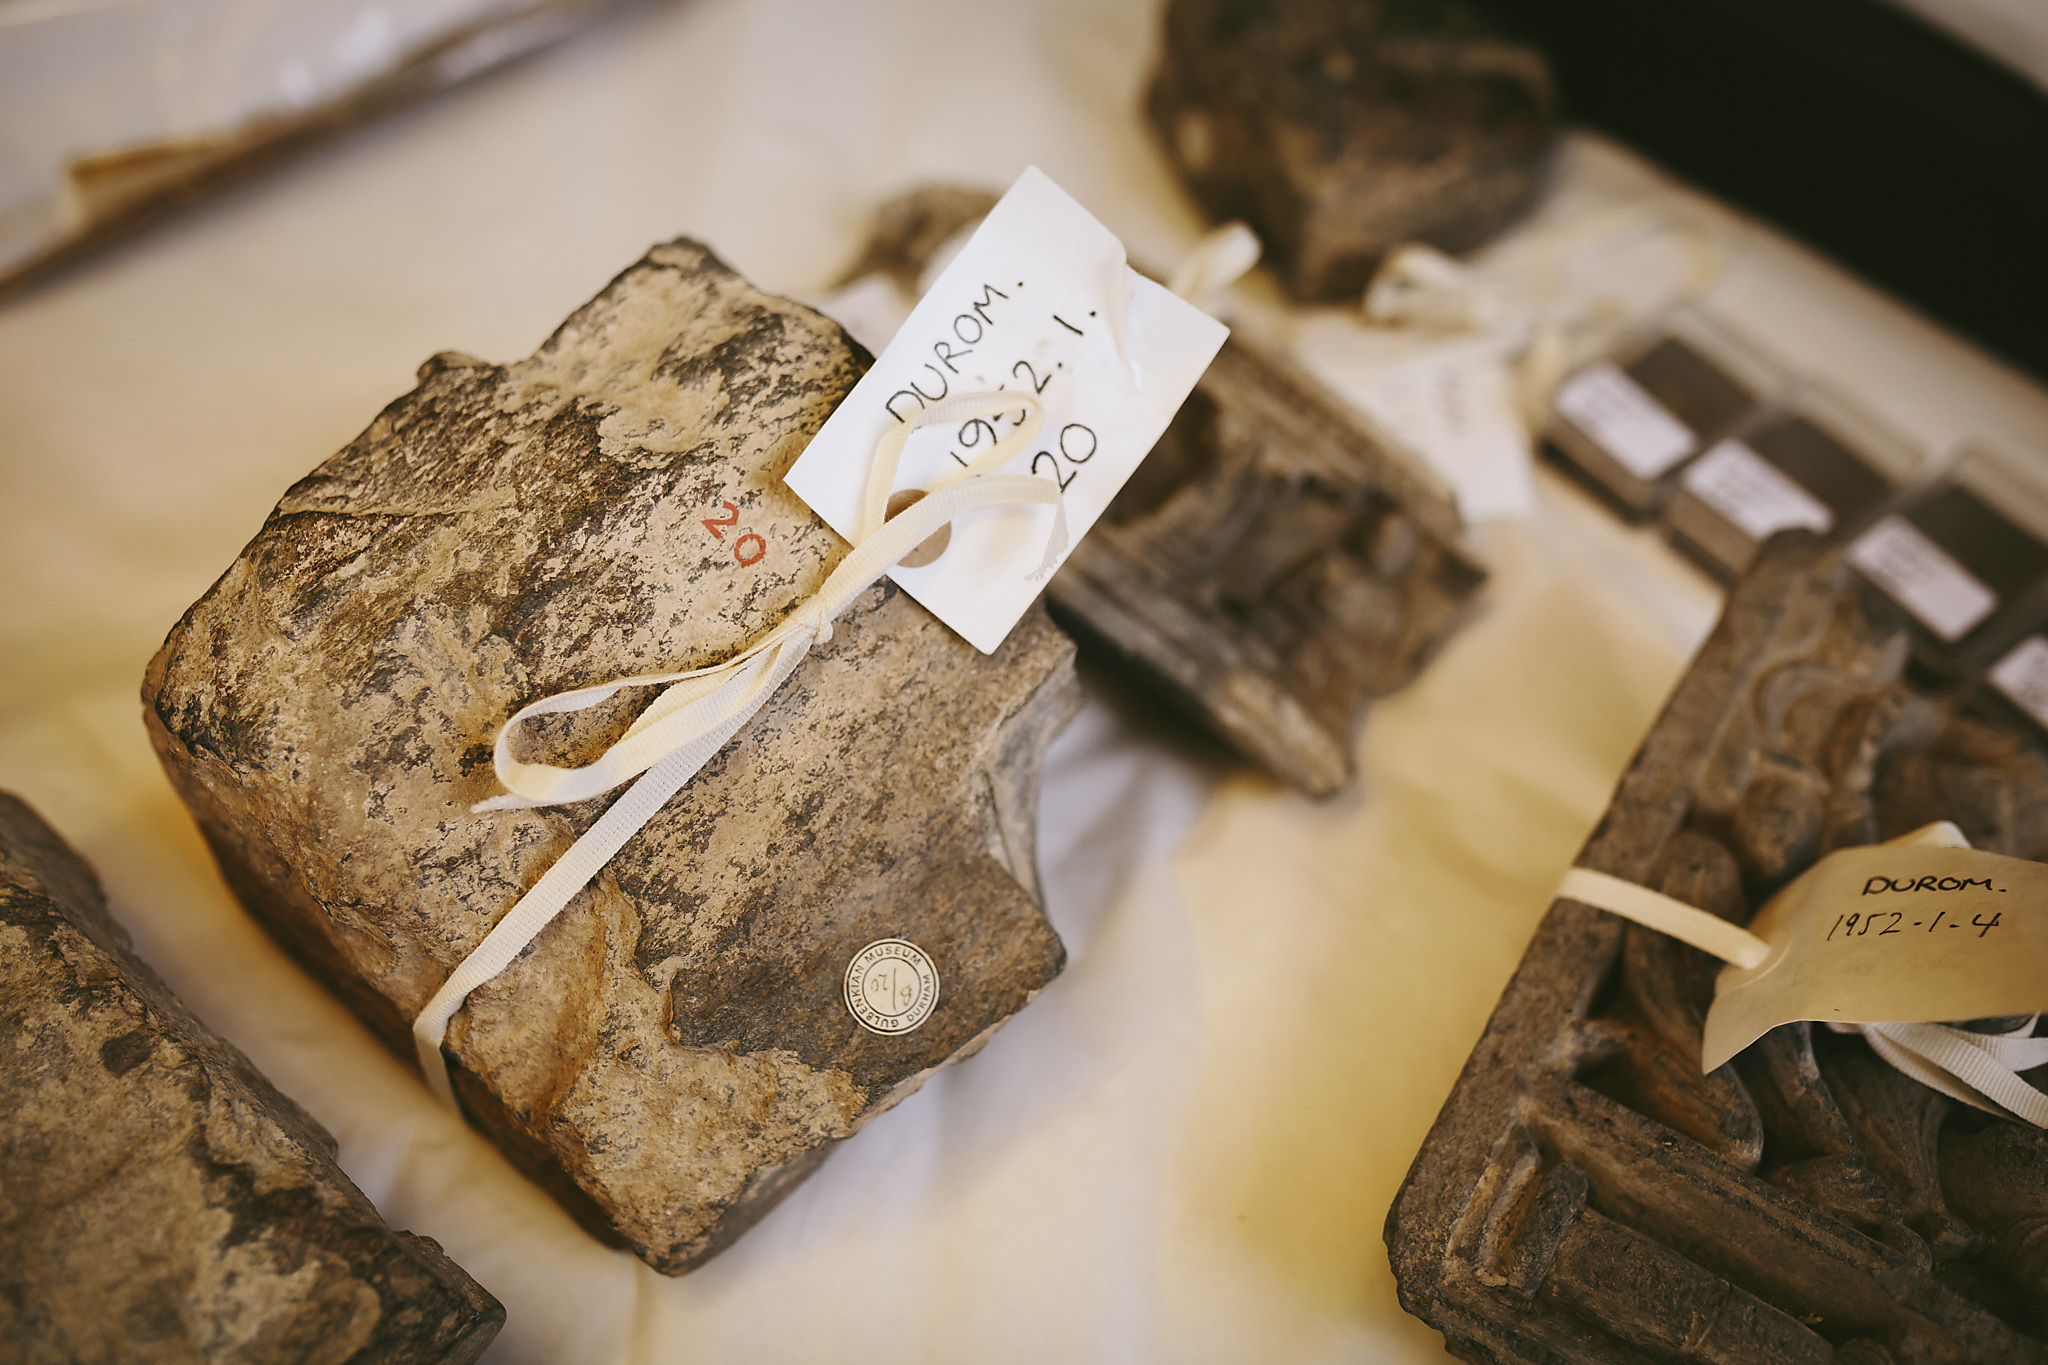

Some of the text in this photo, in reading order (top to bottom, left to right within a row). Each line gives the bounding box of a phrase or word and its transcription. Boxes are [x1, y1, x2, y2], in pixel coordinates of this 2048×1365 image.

[885, 281, 1024, 433] DUROM.
[1032, 423, 1097, 493] 20
[699, 500, 767, 569] 20
[1862, 875, 2008, 897] DUROM.
[850, 946, 922, 1028] GULBENKIAN MUSEUM
[906, 974, 932, 1022] DURHAM
